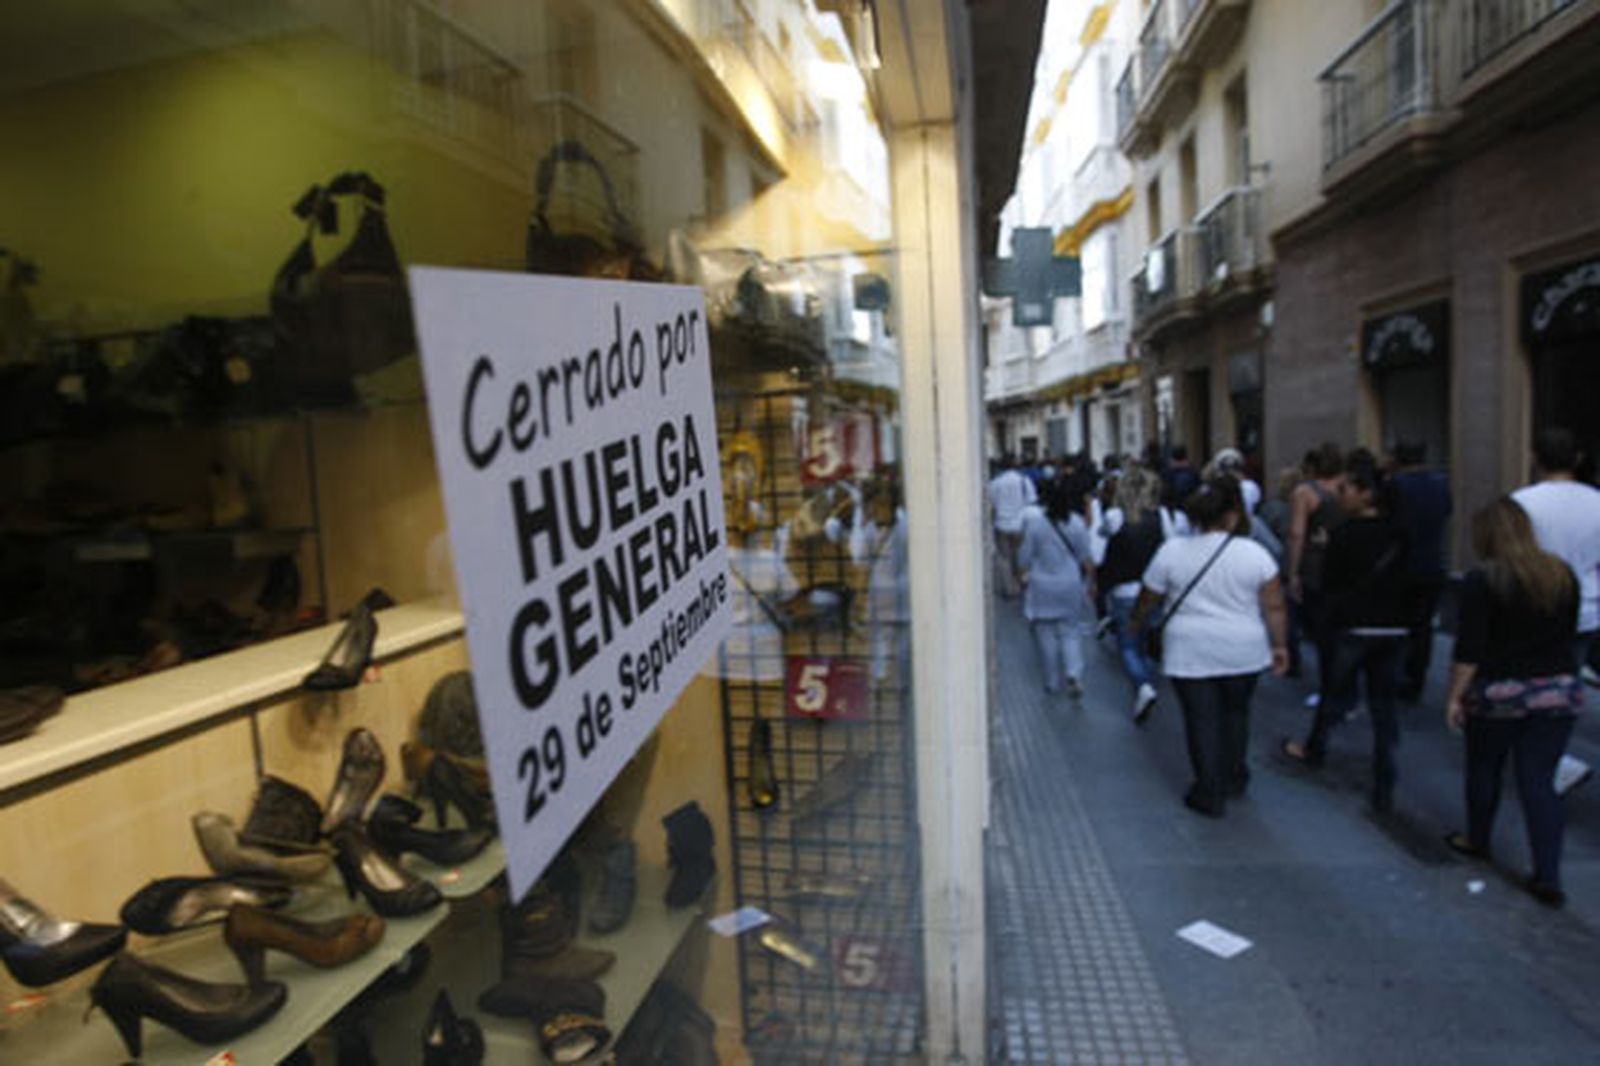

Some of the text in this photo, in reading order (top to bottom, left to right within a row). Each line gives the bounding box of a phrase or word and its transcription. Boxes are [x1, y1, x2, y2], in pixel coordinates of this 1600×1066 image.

[462, 302, 698, 470] Cerrado por
[809, 425, 842, 478] 5
[509, 414, 704, 585] HUELGA
[509, 490, 718, 711] GENERAL
[518, 573, 726, 824] 29 de Septiembre
[794, 664, 829, 711] 5
[841, 942, 877, 986] 5
